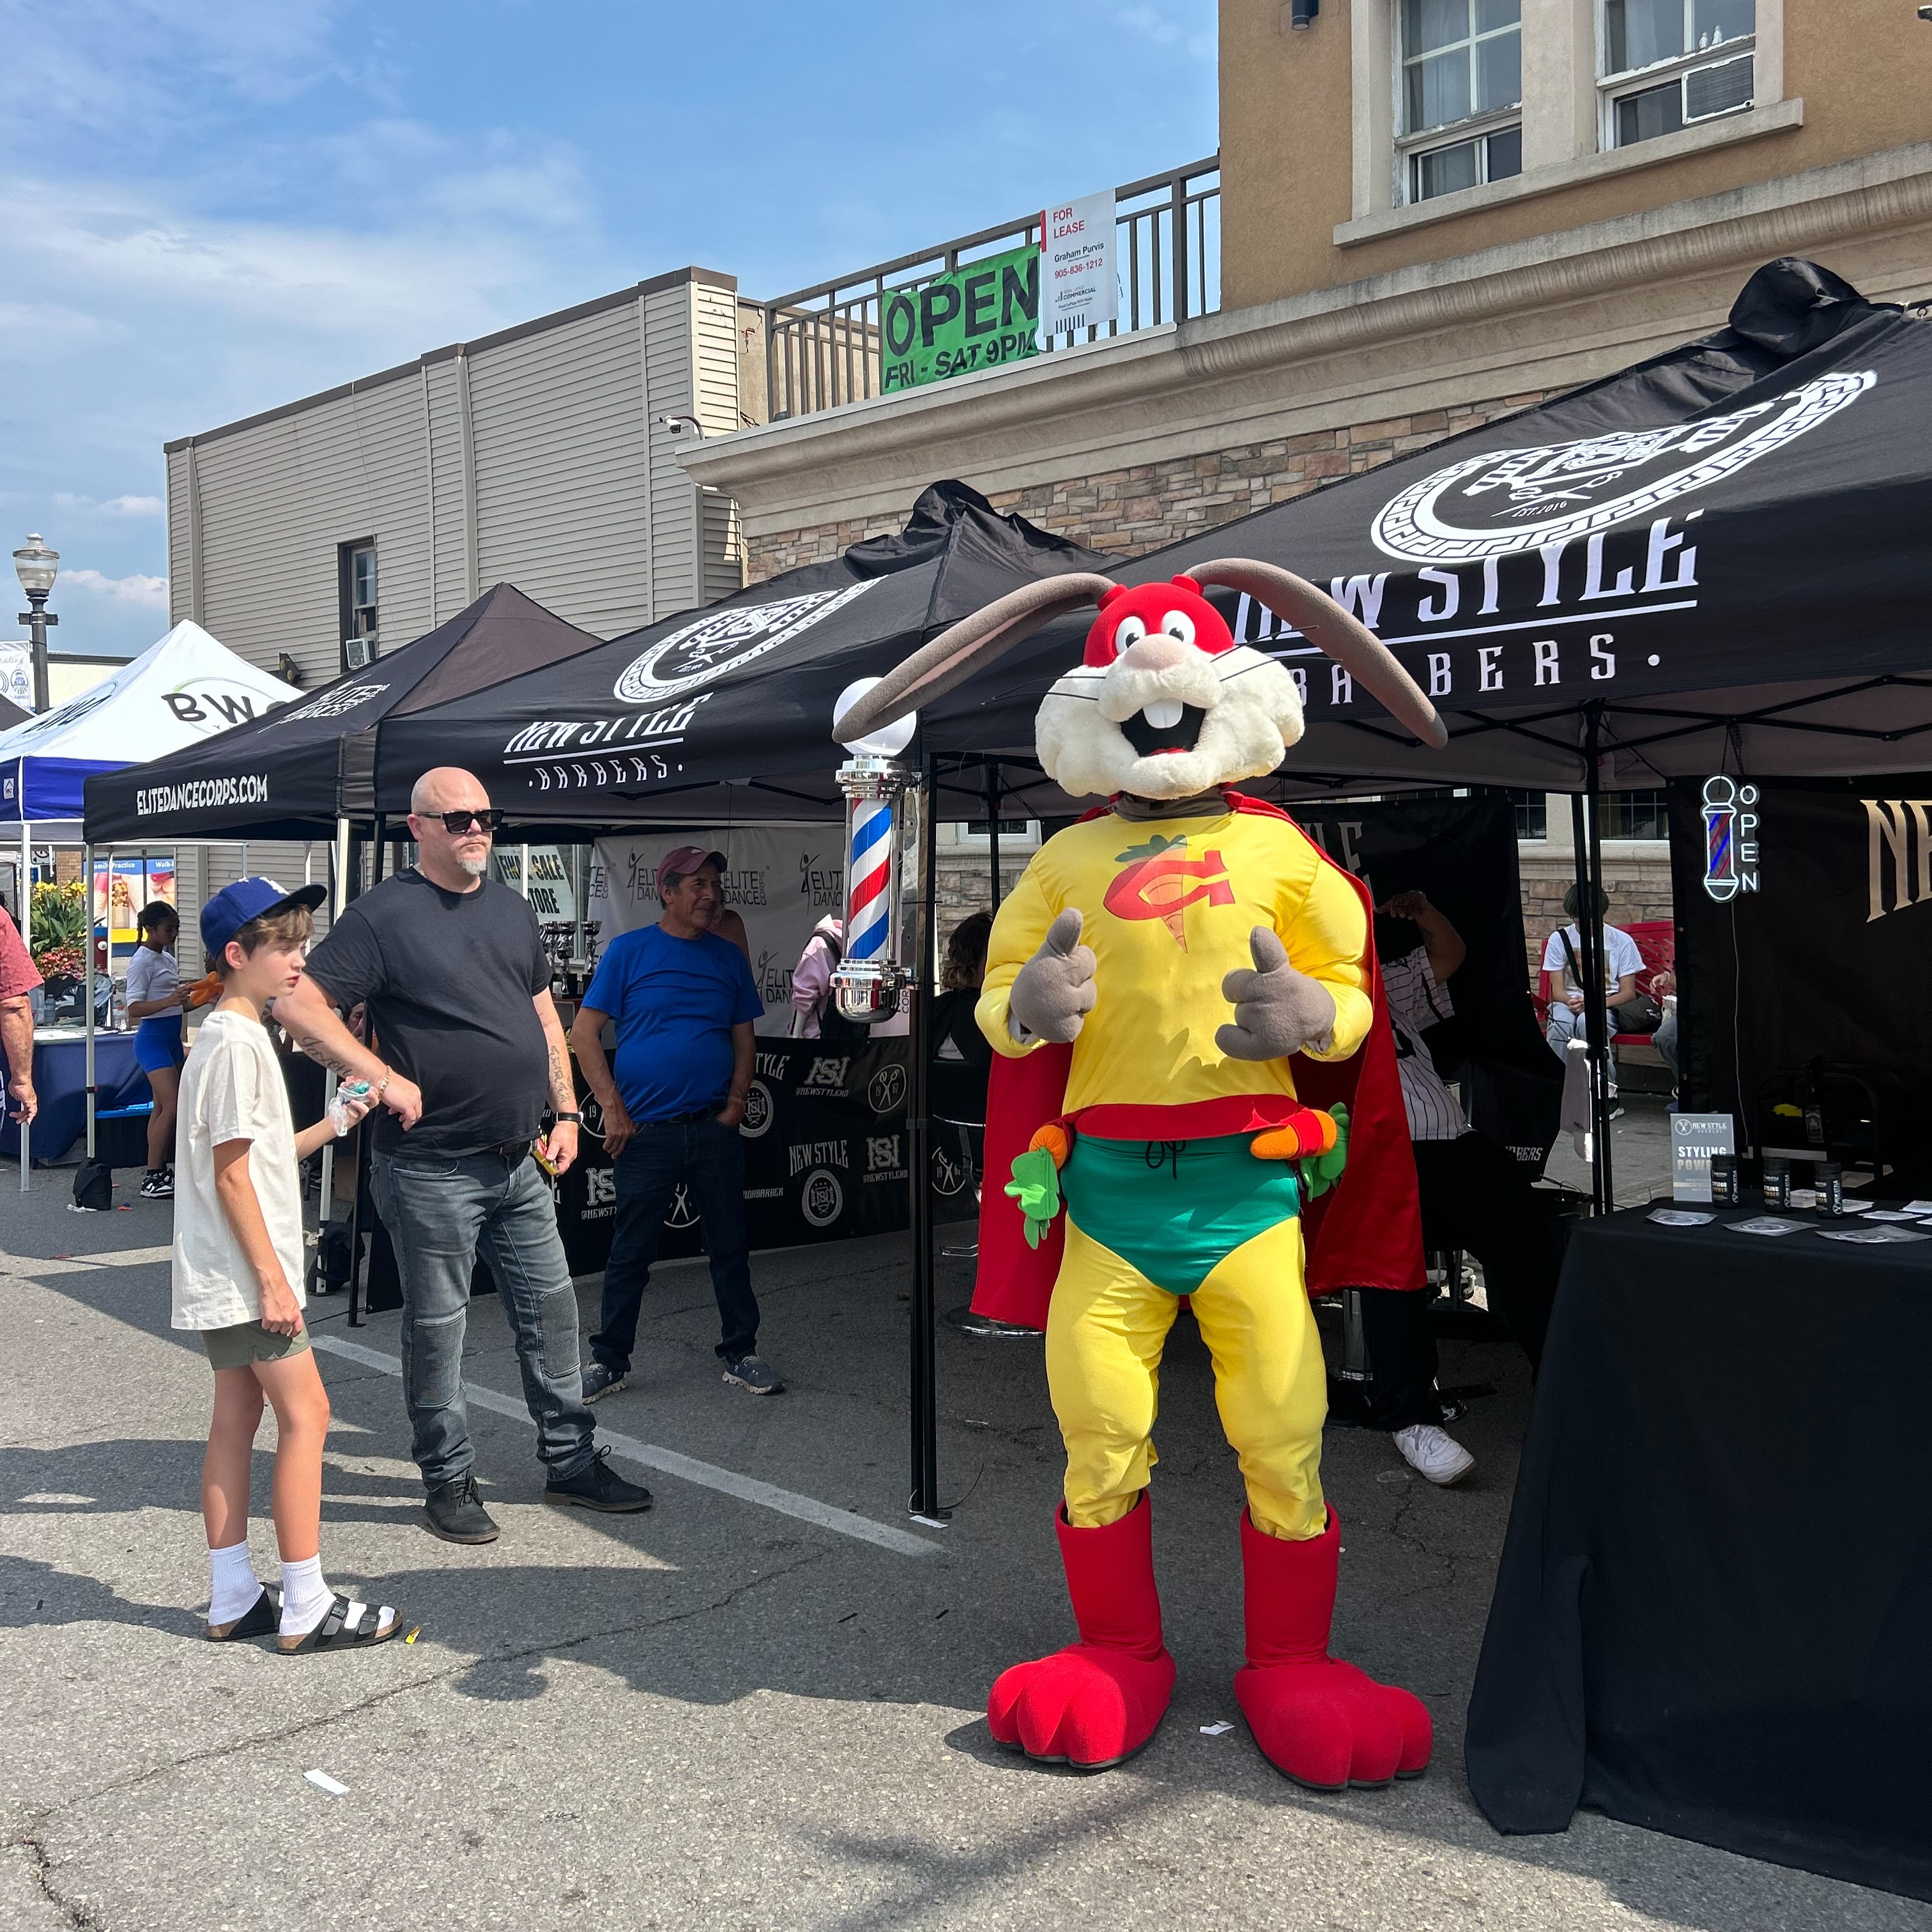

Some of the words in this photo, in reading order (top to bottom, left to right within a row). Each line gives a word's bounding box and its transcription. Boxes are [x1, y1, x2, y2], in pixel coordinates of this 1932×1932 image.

[1054, 208, 1073, 223] FOR
[1054, 220, 1085, 239] LEASE
[1054, 249, 1081, 263] Graham
[1083, 241, 1104, 255] Purvis
[1054, 258, 1103, 279] 905-836-1212
[1063, 287, 1096, 300] COMMERCIAL
[886, 256, 1038, 356] OPEN
[885, 360, 915, 388] FRI
[935, 343, 981, 376] SAT
[986, 327, 1036, 364] 9PM
[1234, 572, 1392, 645] NW
[1417, 509, 1704, 622] STYLE
[1292, 633, 1615, 706] BABERS
[161, 693, 288, 724] BW
[535, 755, 667, 790] BARBERS
[137, 773, 268, 816] ELITEDANCECORPS.COM
[1739, 785, 1758, 891] OPEN
[531, 854, 565, 880] SALE
[1859, 799, 1932, 923] NE
[723, 870, 758, 889] ELITE
[811, 871, 843, 890] ELIT
[637, 887, 660, 900] DAN
[724, 890, 760, 905] DANCE
[813, 891, 843, 906] DANC
[767, 969, 795, 988] ELIT
[767, 988, 791, 1003] DAN
[901, 990, 910, 1014] COR
[755, 1052, 791, 1081] TYLE
[788, 1142, 813, 1177] NEW
[815, 1139, 849, 1170] STYLE
[1678, 1146, 1728, 1158] STYLING
[581, 1206, 618, 1220] @NEWSTY
